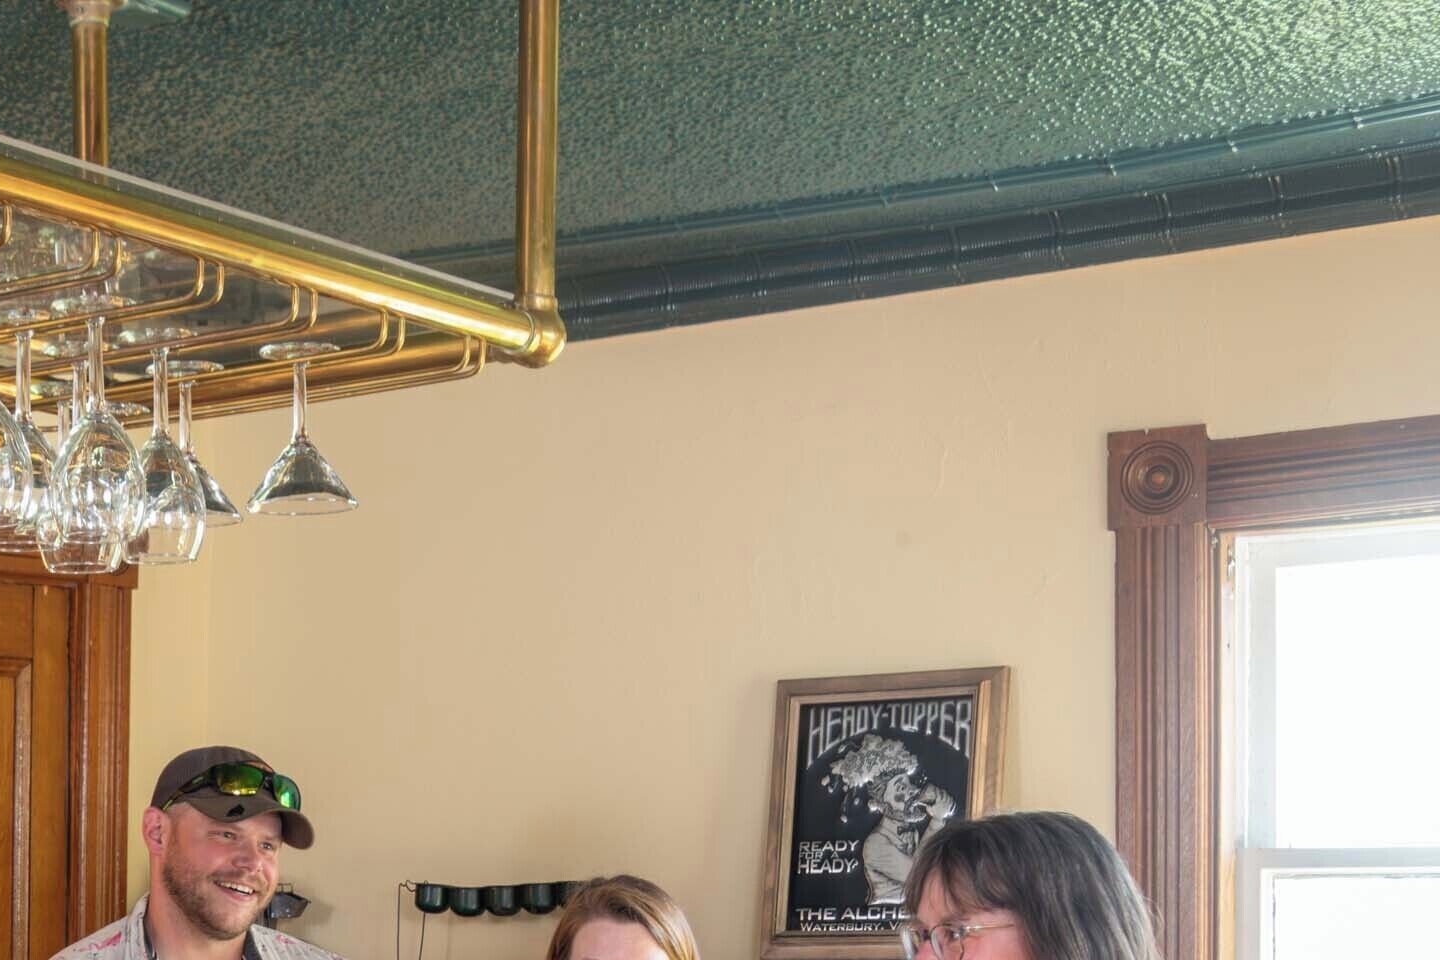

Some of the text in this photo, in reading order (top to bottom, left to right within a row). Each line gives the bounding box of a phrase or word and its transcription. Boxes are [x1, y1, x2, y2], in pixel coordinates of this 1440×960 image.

[807, 699, 972, 768] HEADY-TOPPER
[800, 840, 859, 852] READY
[800, 851, 823, 860] FOR
[796, 907, 837, 920] THE
